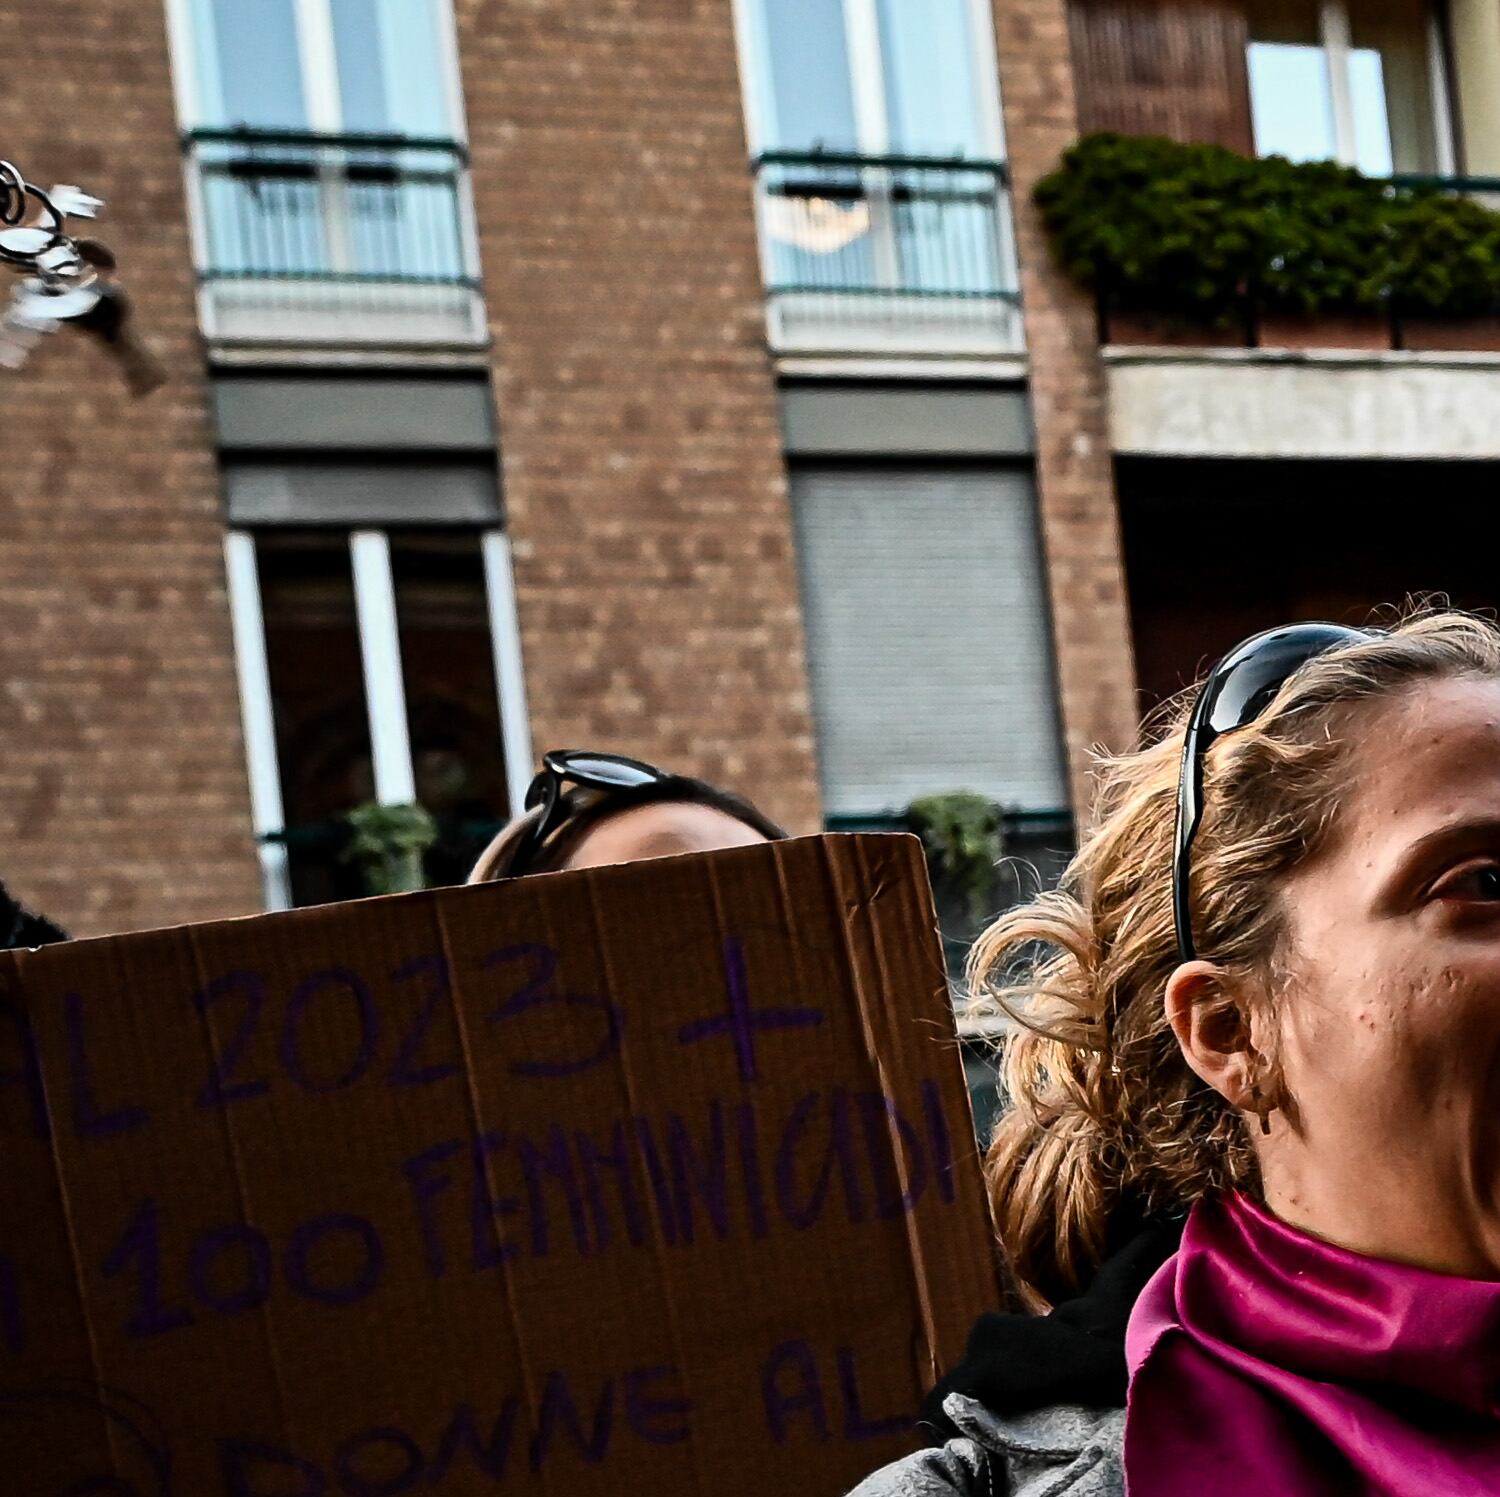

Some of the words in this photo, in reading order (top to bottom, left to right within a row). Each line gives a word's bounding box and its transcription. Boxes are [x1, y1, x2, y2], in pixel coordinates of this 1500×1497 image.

[193, 941, 627, 1111] 2023
[101, 1196, 386, 1341] 100
[759, 1338, 929, 1448] AL
